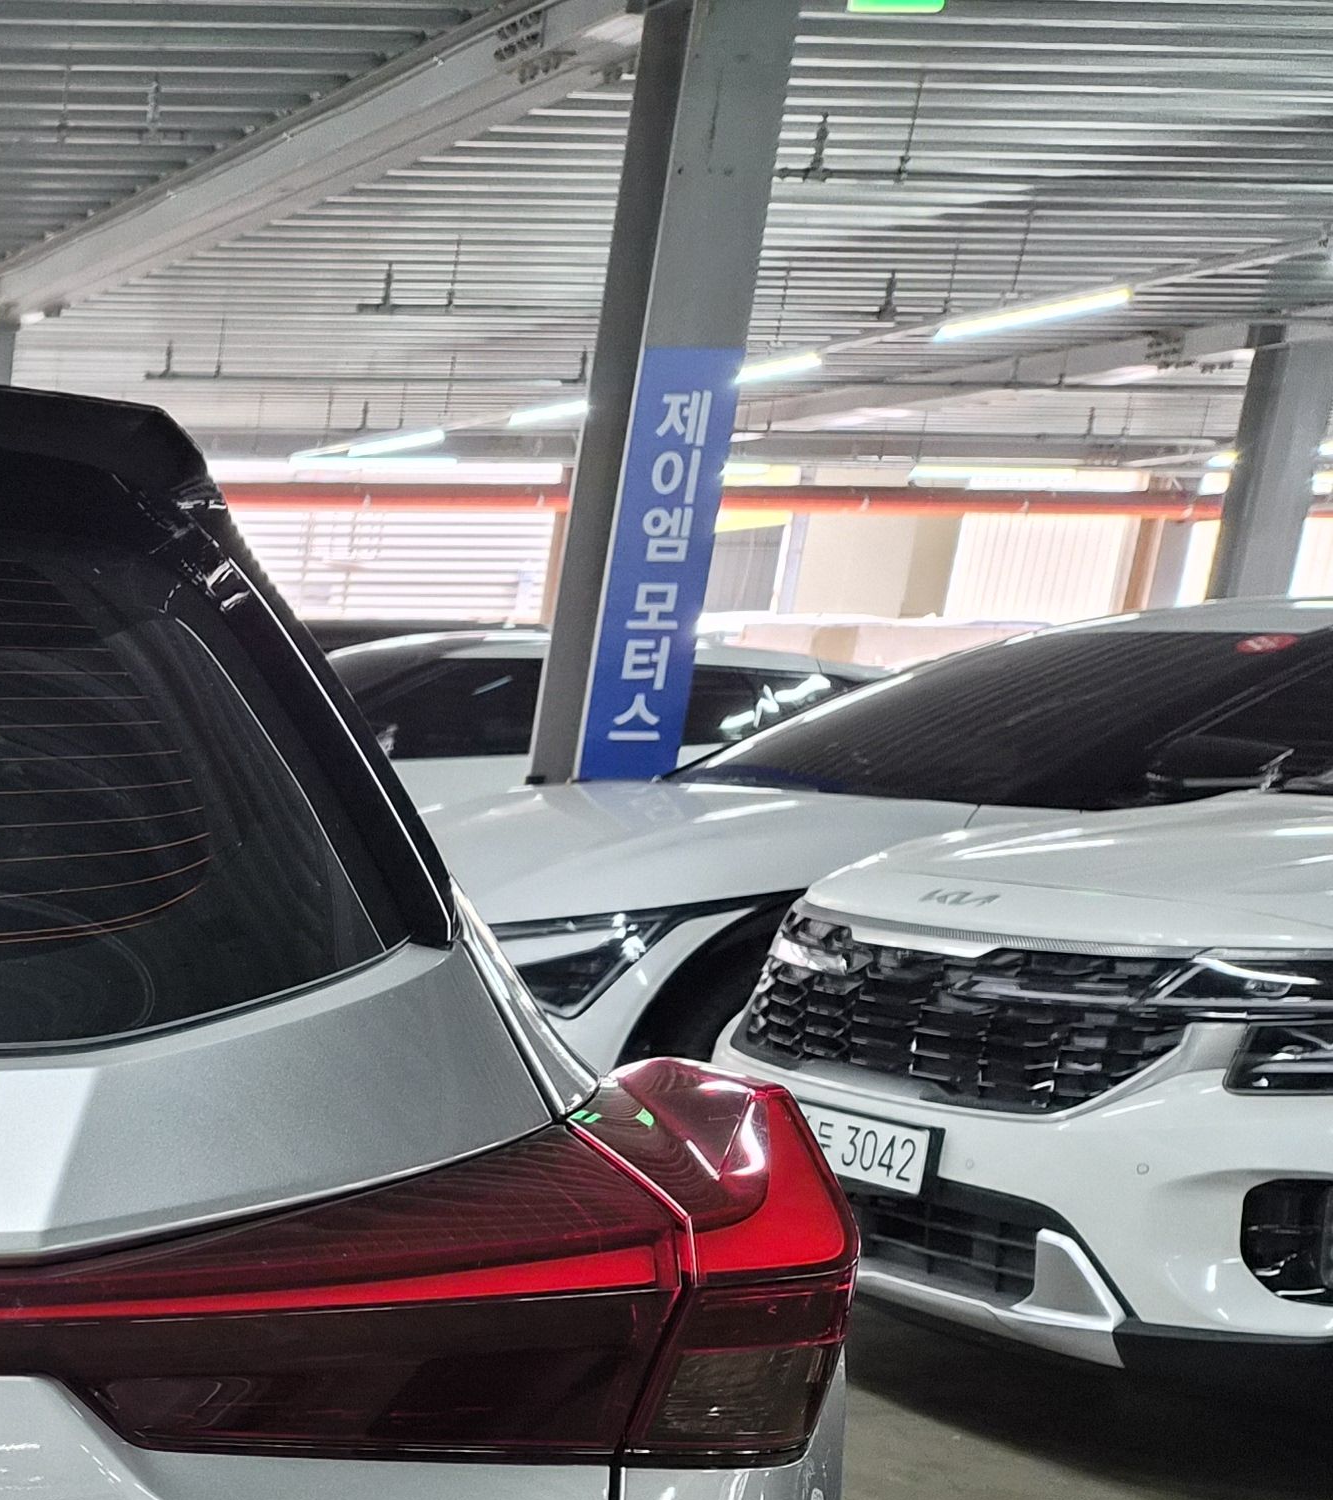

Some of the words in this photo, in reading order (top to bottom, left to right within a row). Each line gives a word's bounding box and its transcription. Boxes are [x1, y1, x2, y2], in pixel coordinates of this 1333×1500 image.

[641, 390, 713, 564] 제이엠
[607, 581, 679, 742] 모터스
[841, 1125, 917, 1183] 3042
